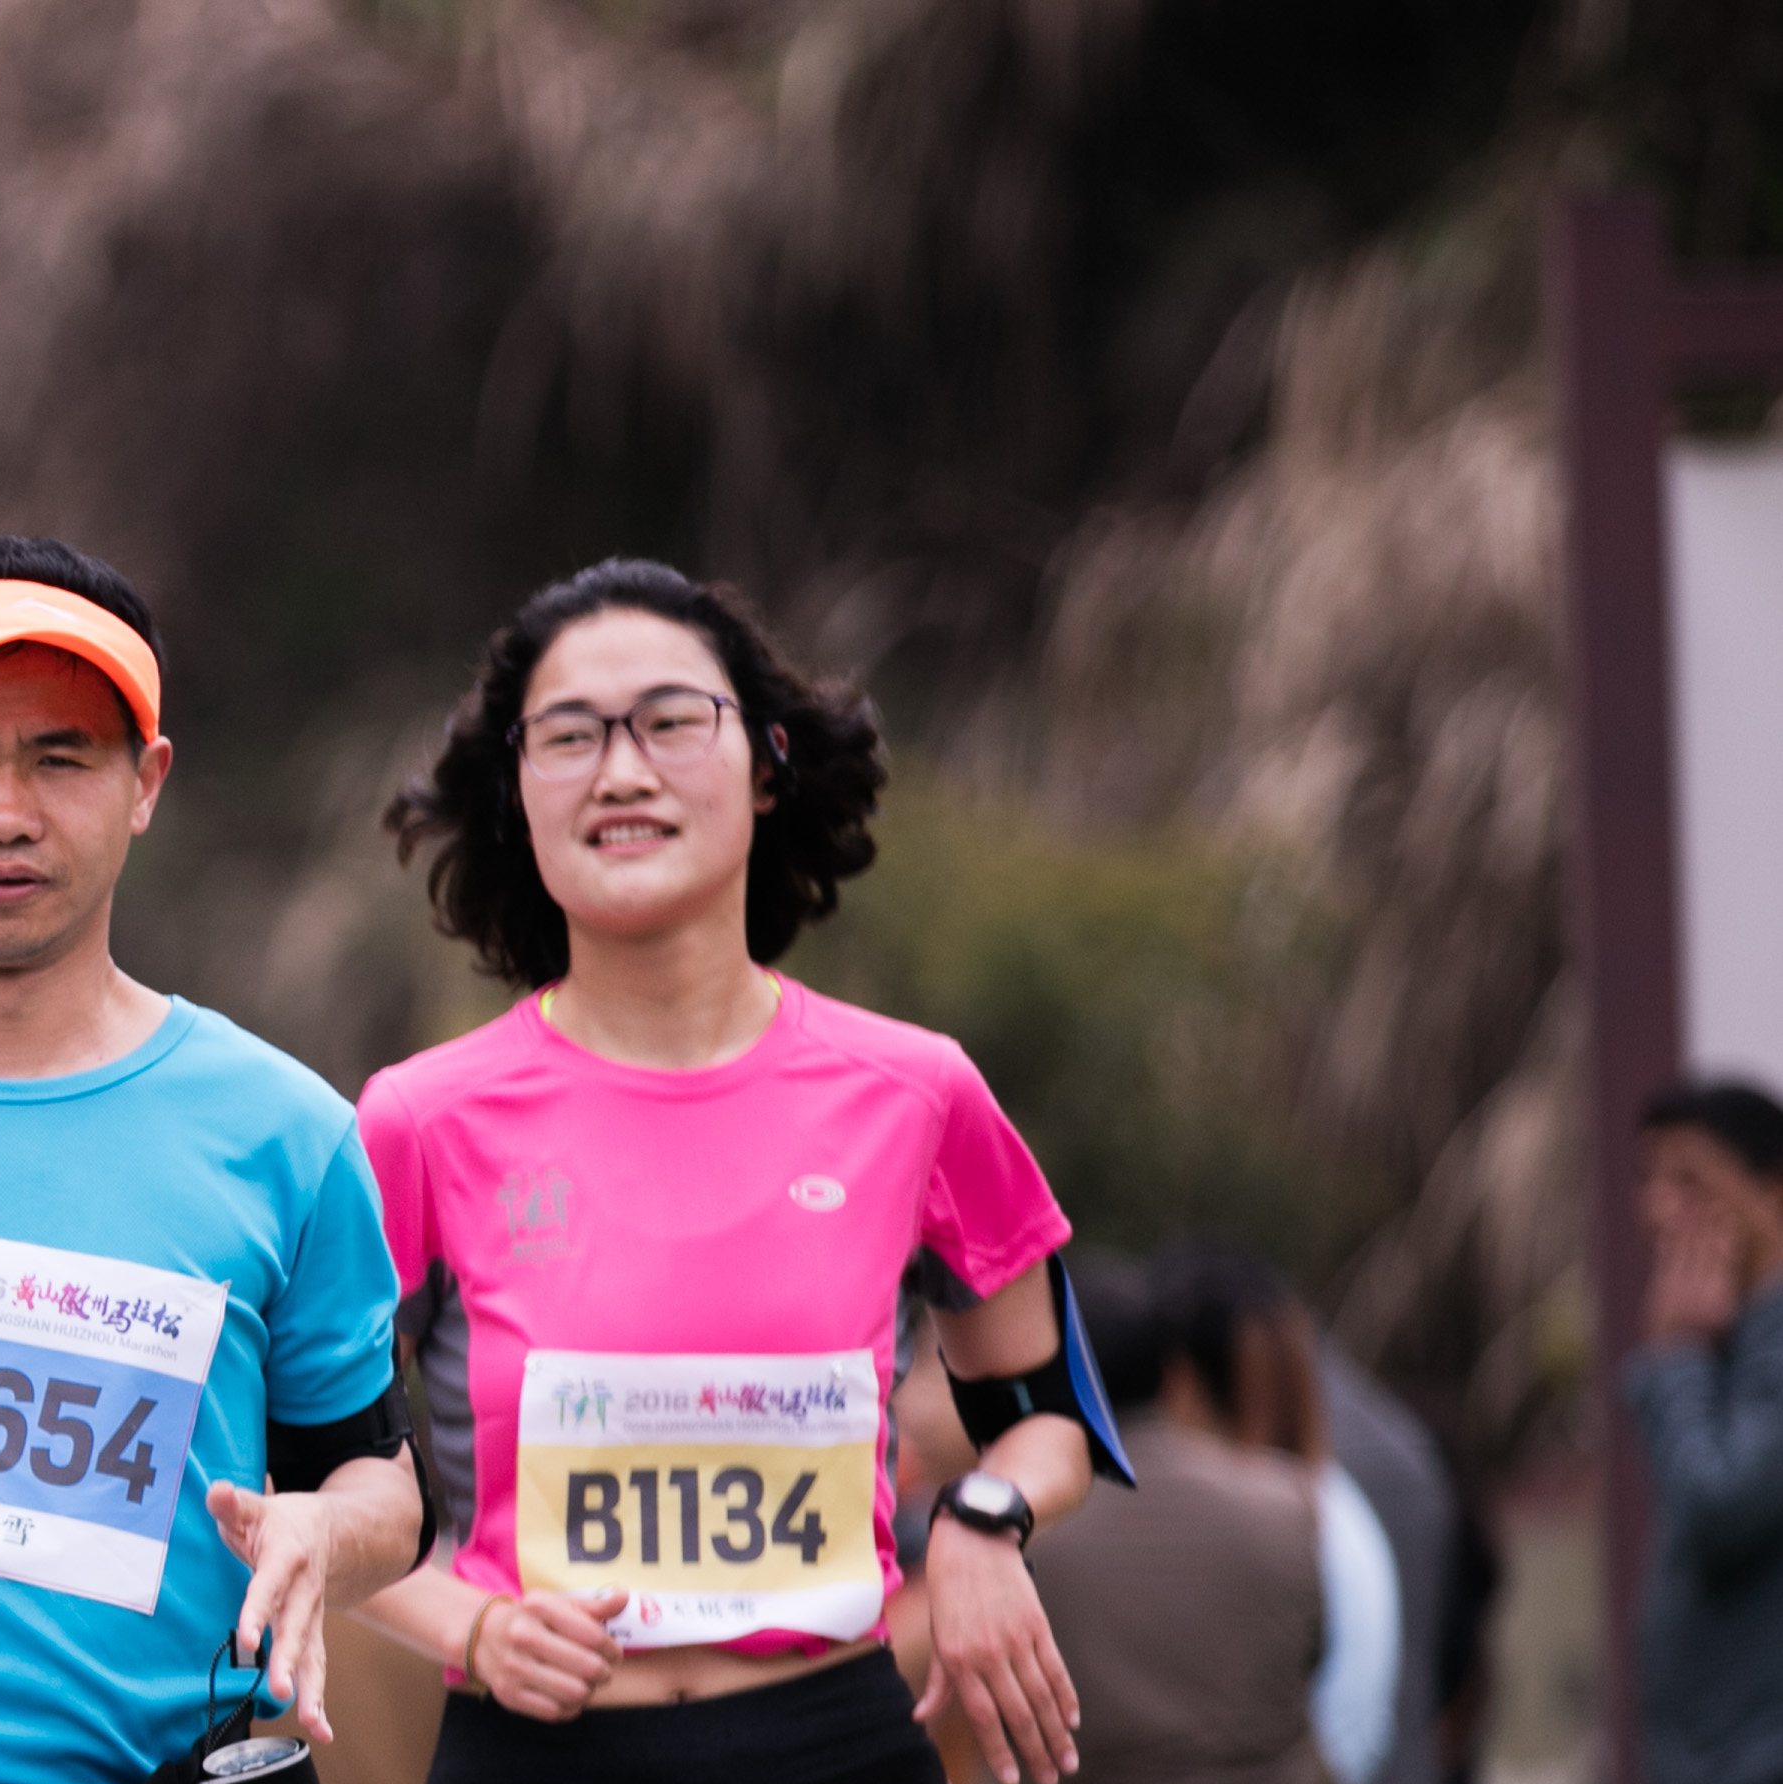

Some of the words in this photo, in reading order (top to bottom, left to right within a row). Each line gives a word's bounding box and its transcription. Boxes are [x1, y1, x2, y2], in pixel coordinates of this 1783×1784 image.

[11, 1273, 183, 1340] 黄山徽州马拉松
[54, 1323, 116, 1347] HUIZHOU
[119, 1336, 179, 1362] Marathon
[566, 1465, 827, 1566] B1134
